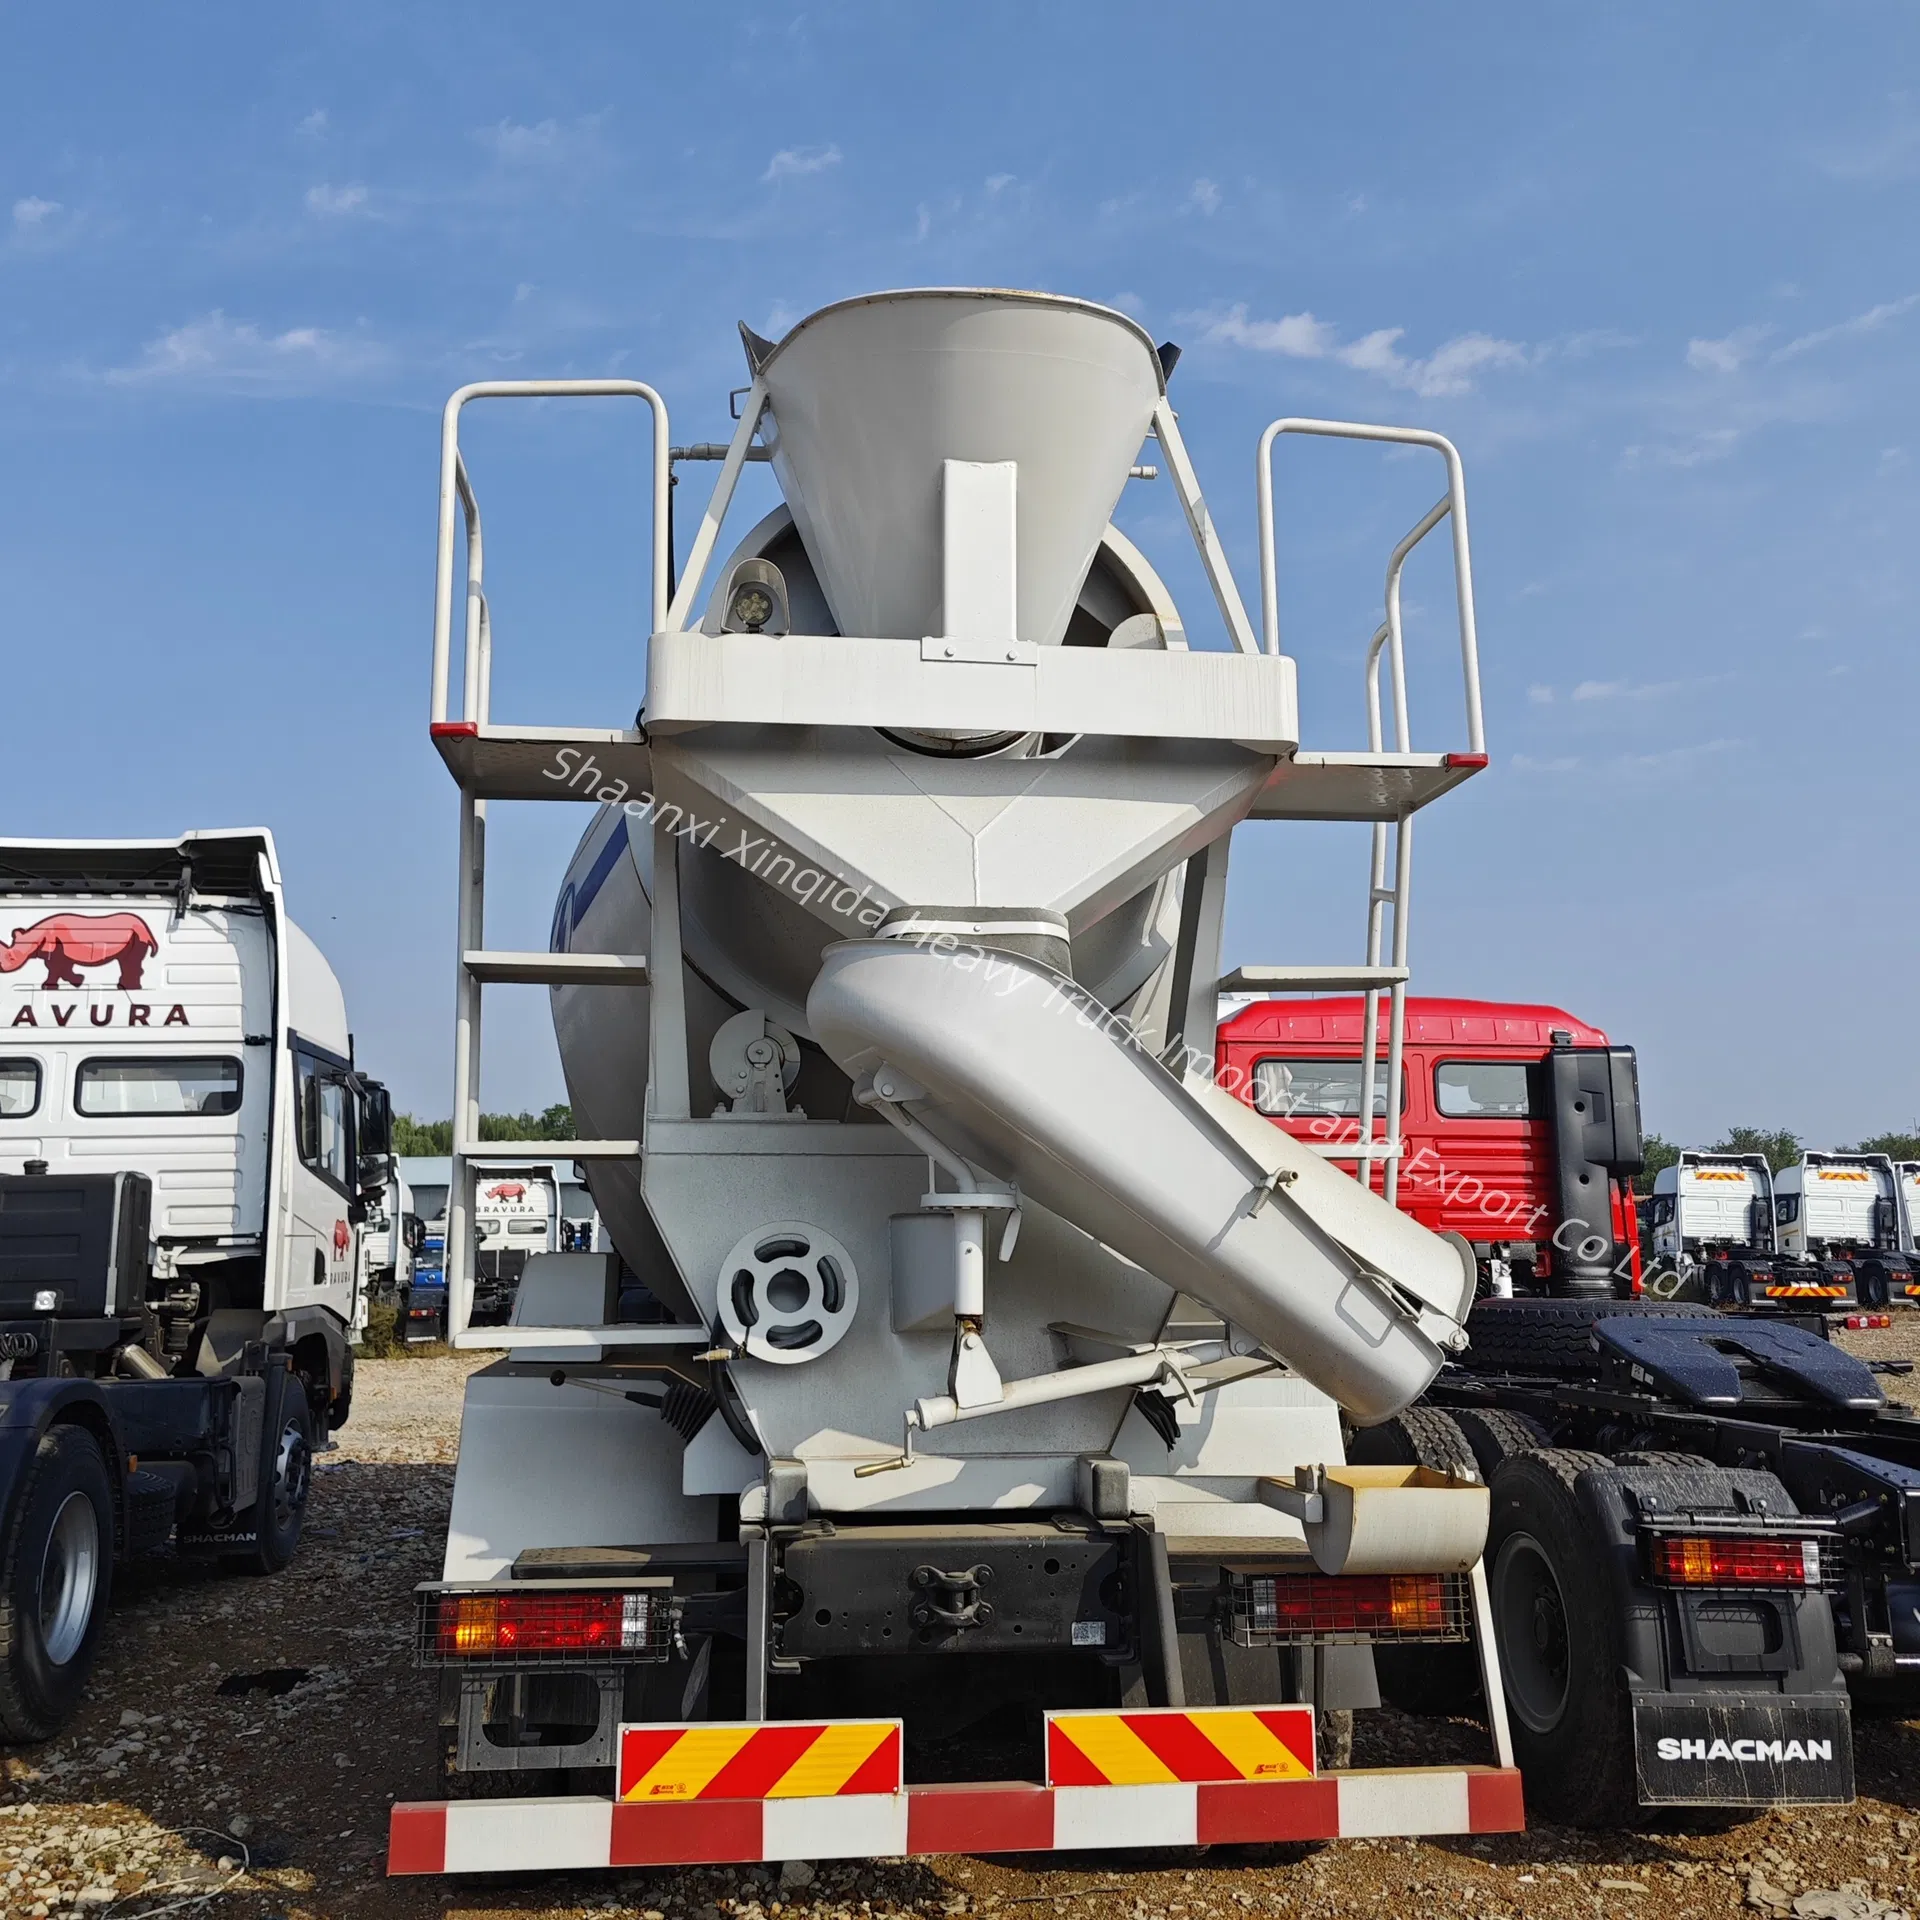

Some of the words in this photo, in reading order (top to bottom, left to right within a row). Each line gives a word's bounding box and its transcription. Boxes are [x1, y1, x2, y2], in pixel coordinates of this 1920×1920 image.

[11, 1004, 190, 1027] AVURA
[183, 1532, 257, 1543] SHACMAN
[1656, 1737, 1833, 1762] SHACMAN
